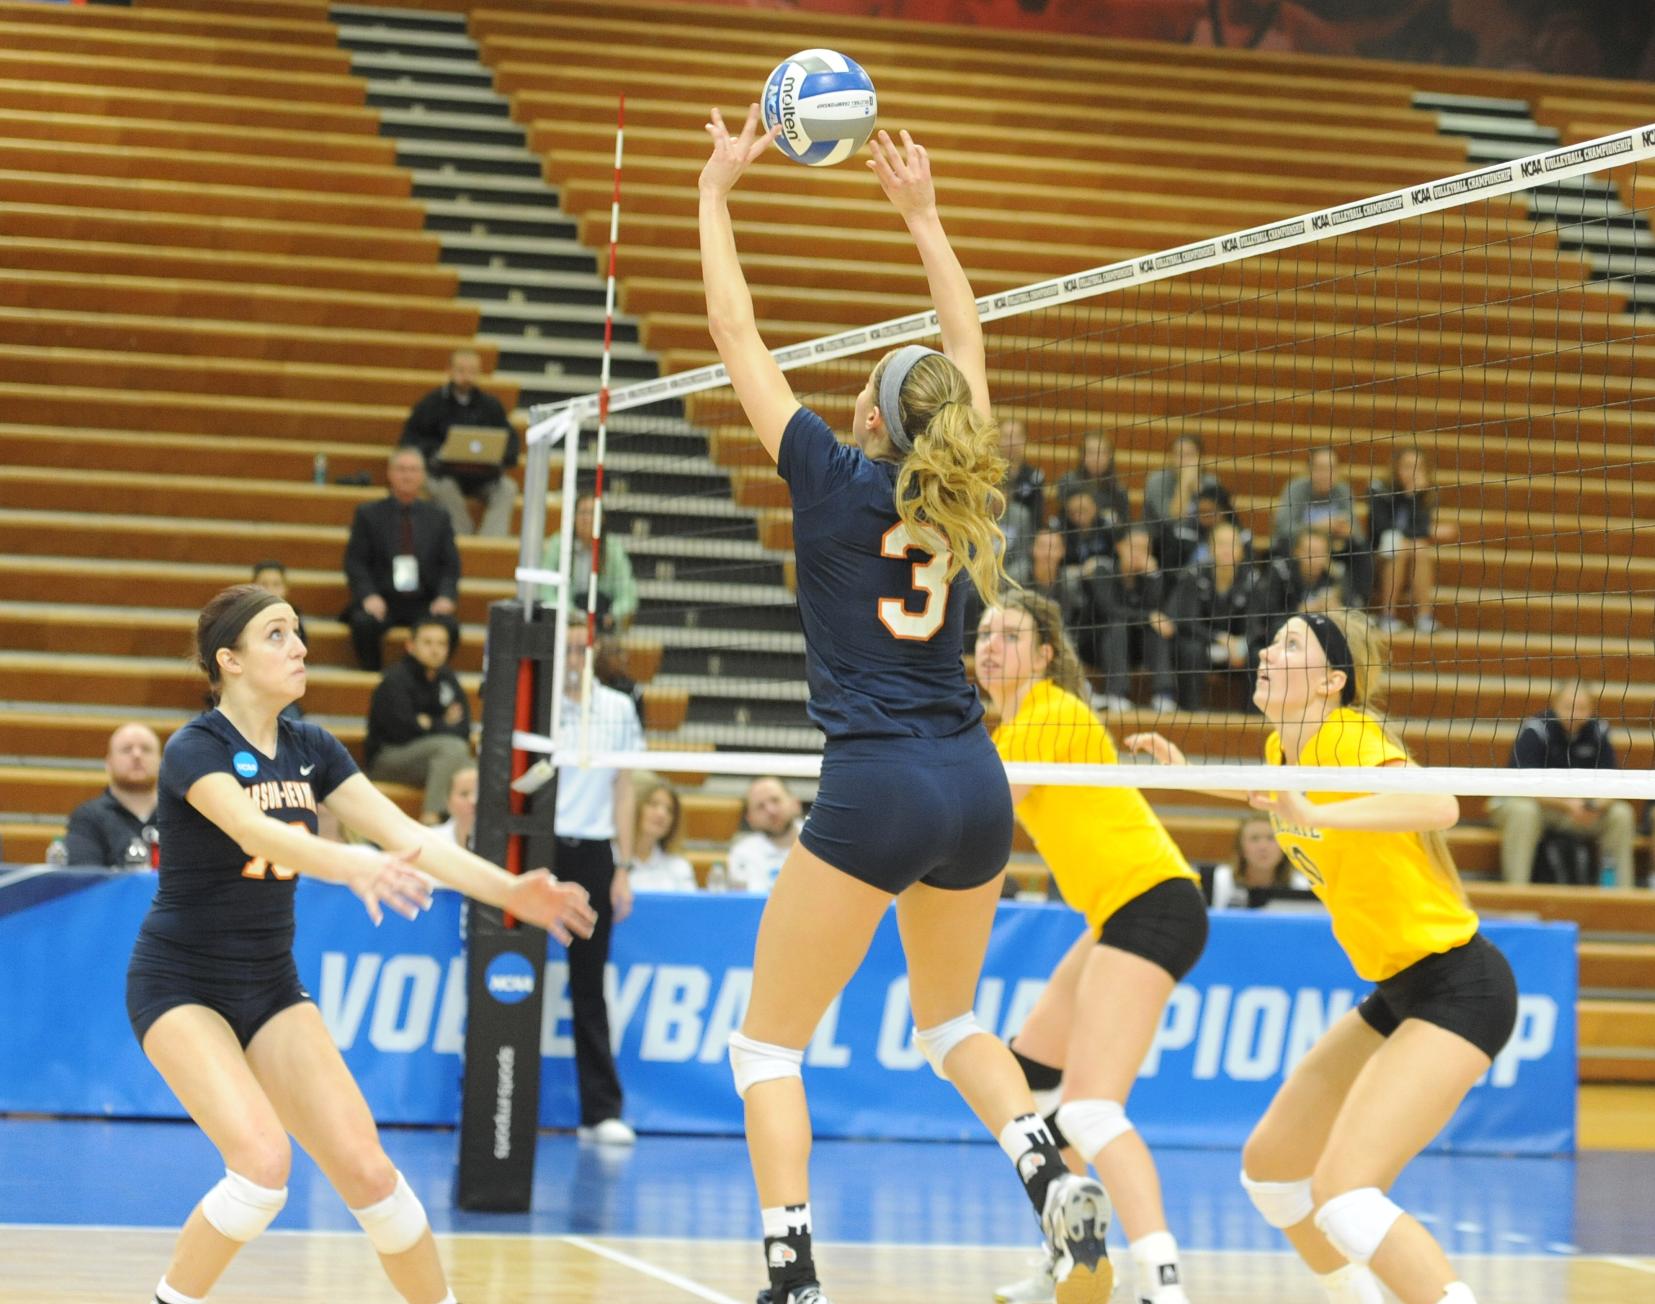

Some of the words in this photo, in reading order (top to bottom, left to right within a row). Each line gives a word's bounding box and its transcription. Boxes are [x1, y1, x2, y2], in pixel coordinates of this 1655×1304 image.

[782, 76, 798, 140] molten
[1520, 158, 1544, 178] NCAA
[1545, 150, 1584, 172] VOLLEYBALL
[1583, 136, 1633, 162] CHAMPIONSHIP
[1411, 187, 1433, 206] NCAA
[1433, 178, 1468, 199] VOLLEYBALL
[1467, 167, 1512, 190] CHAMPIONSHIP
[1312, 214, 1332, 230] NCAA
[1221, 237, 1240, 253] NCAA
[878, 519, 952, 642] 3
